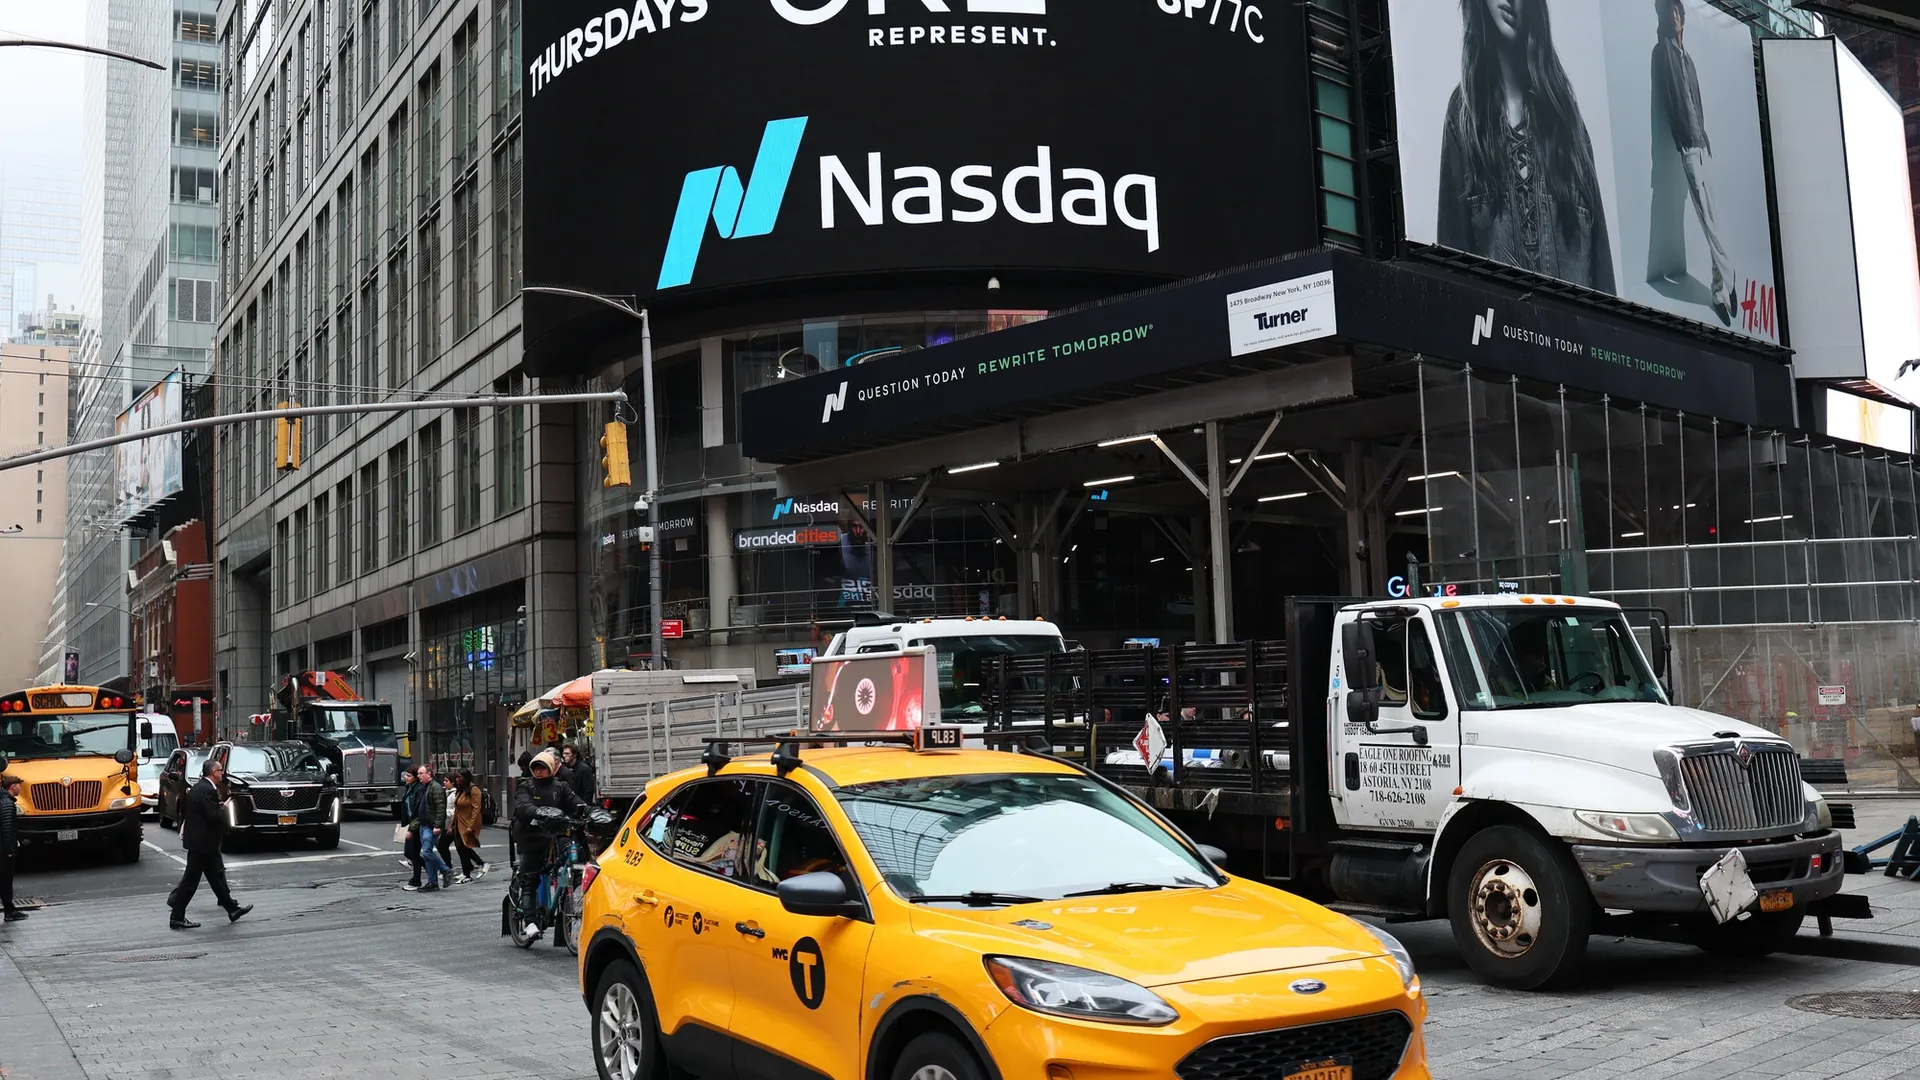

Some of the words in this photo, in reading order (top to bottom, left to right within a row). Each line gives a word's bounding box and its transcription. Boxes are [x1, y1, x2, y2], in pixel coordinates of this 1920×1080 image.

[868, 26, 1057, 47] REPRESENT.
[529, 0, 709, 97] THURSDAYS
[820, 146, 1159, 253] Nasdaq
[1230, 299, 1243, 308] 1475
[1244, 293, 1272, 305] Broadway
[1303, 283, 1312, 291] NY
[1313, 278, 1331, 288] 10036
[1741, 278, 1774, 340] H&M
[1254, 307, 1308, 331] Turner
[1503, 324, 1551, 348] QUESTION
[1554, 337, 1583, 355] TODAY
[1590, 347, 1631, 368] REWRITE
[858, 377, 919, 401] QUESTION
[924, 367, 966, 387] TODAY
[978, 349, 1046, 375] REWRITE
[794, 500, 839, 515] Nasdaq
[862, 499, 914, 511] RERIT
[658, 517, 694, 532] MORROW
[738, 529, 837, 548] brandedcities
[931, 730, 955, 744] 9L83
[1359, 747, 1381, 760] EAGLE
[1382, 748, 1398, 761] ONE
[1399, 749, 1432, 762] ROOFING
[1360, 761, 1367, 774] 18
[1369, 761, 1378, 774] 60
[1379, 762, 1398, 775] 45TH
[1400, 763, 1432, 777] STREET
[1362, 776, 1400, 789] ASTORIA,
[1401, 777, 1413, 790] NY
[1414, 777, 1432, 791] 2108
[1369, 790, 1426, 805] 718-626-2108
[1379, 818, 1396, 827] GVW
[624, 849, 644, 867] 9L83
[772, 947, 788, 961] NYC
